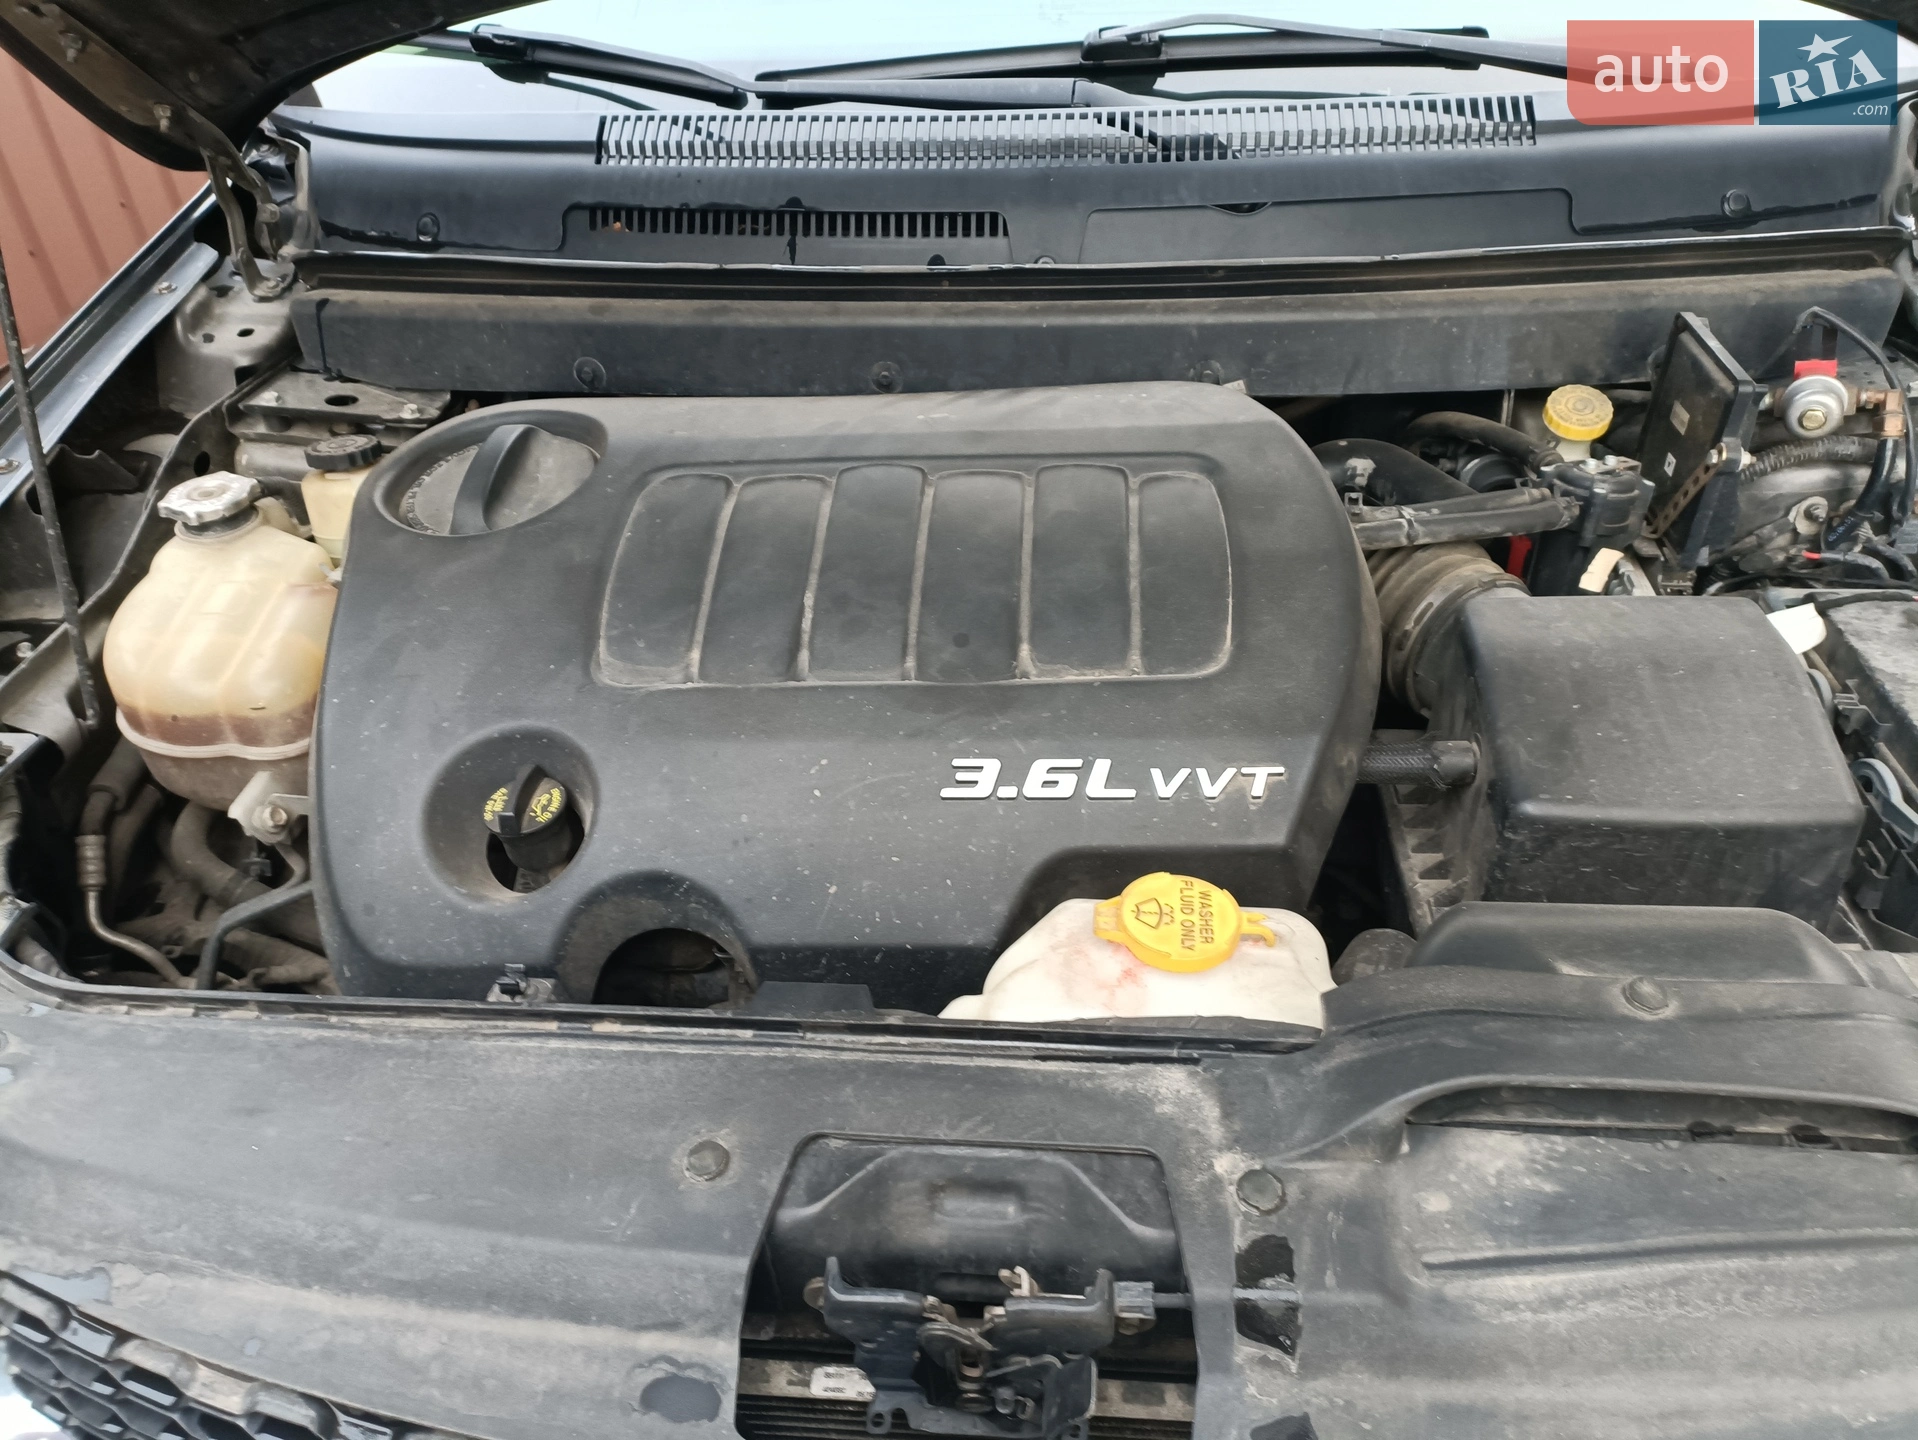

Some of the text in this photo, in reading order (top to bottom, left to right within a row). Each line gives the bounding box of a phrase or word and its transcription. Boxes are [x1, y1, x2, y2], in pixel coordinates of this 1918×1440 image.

[939, 758, 1286, 799] 3.6L VVT
[1180, 879, 1196, 951] FLUID ONLY
[1198, 890, 1214, 944] WASHER
